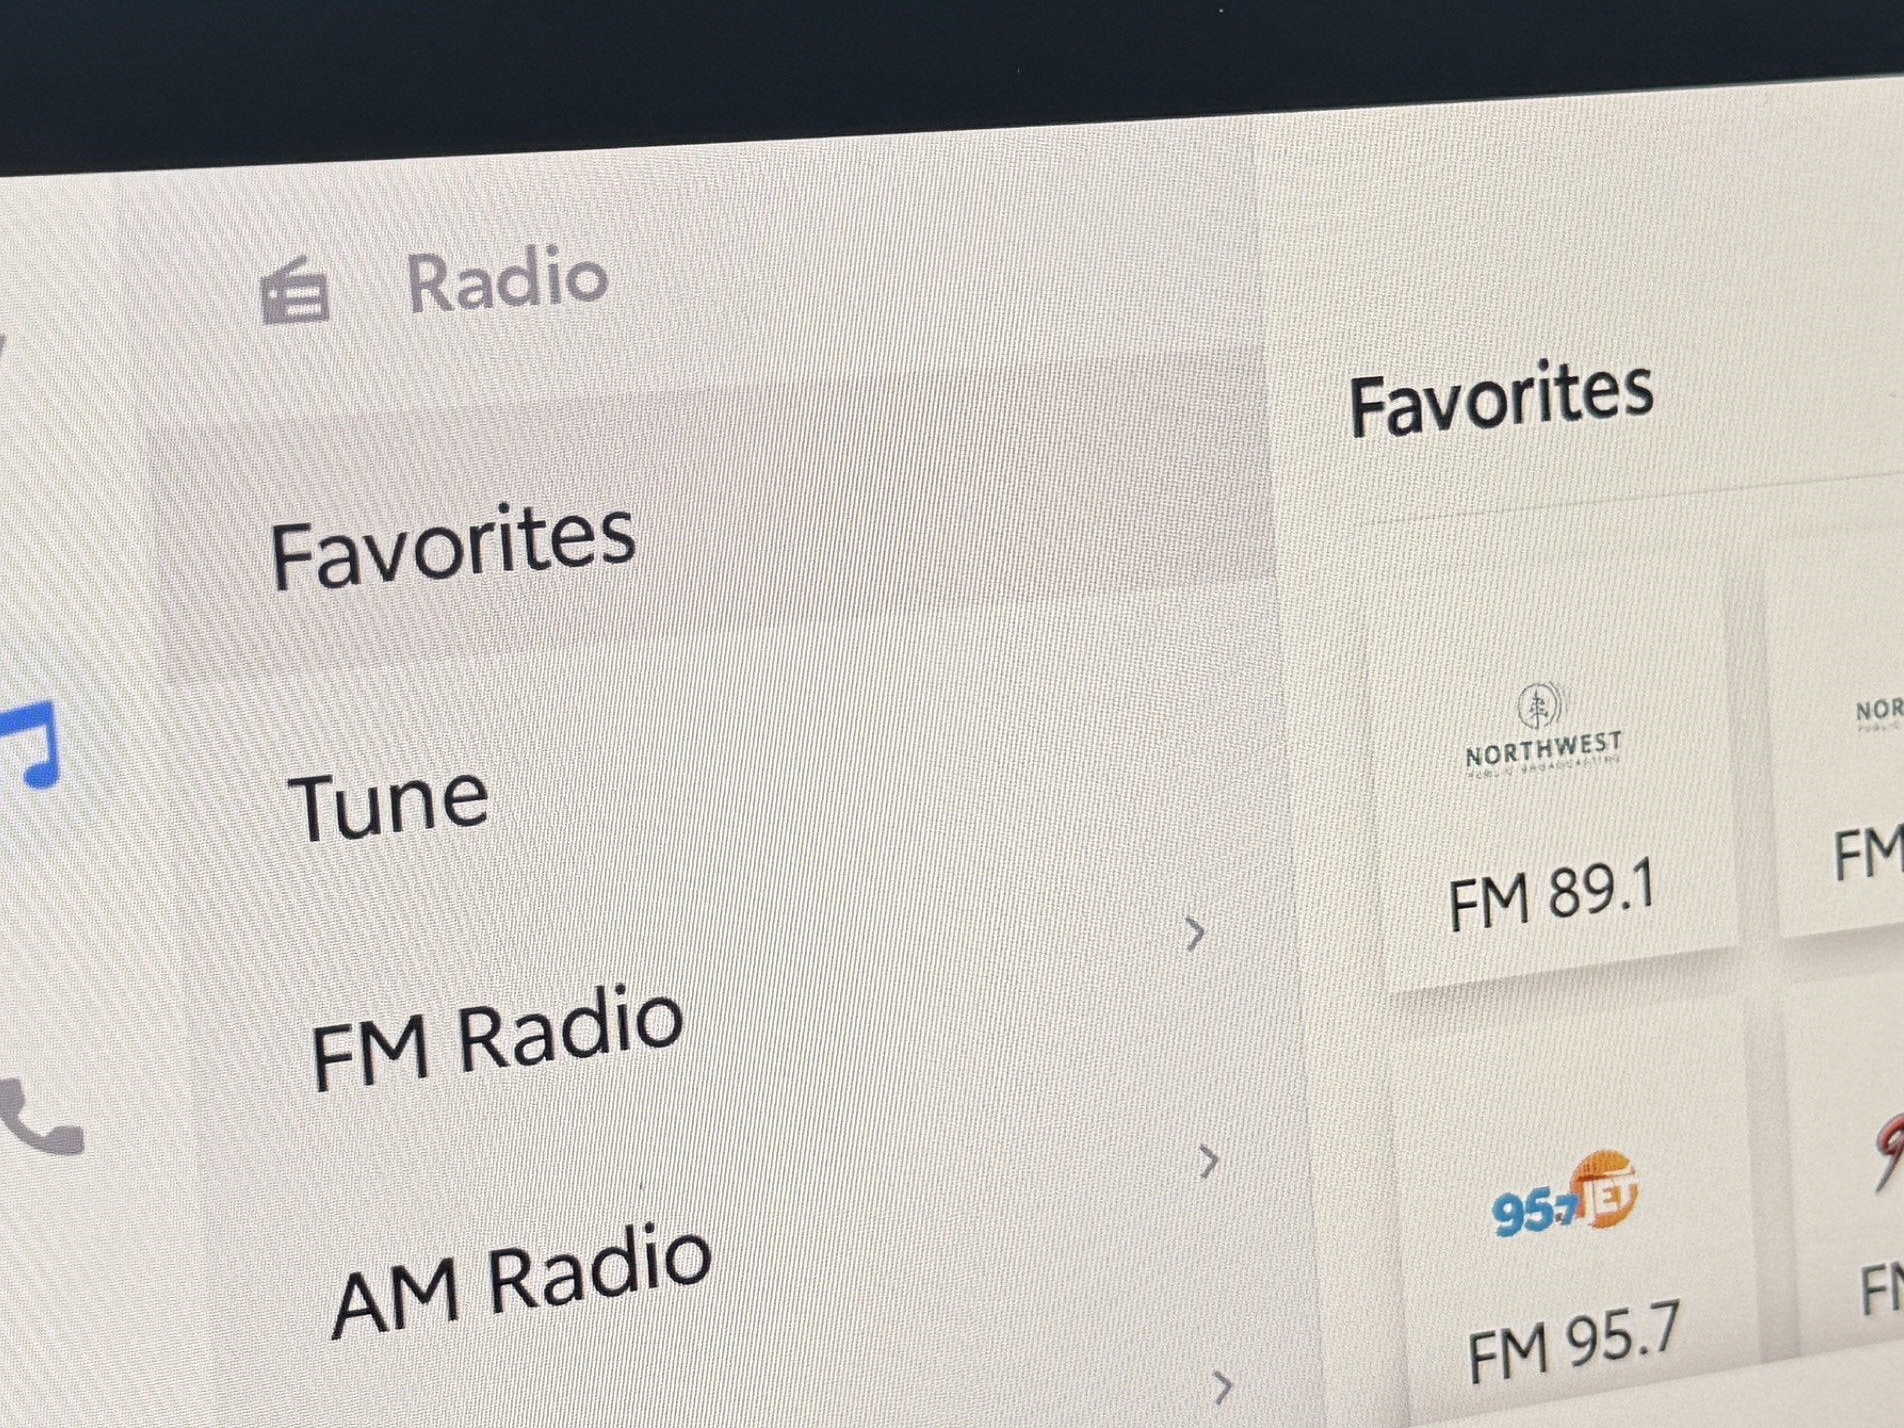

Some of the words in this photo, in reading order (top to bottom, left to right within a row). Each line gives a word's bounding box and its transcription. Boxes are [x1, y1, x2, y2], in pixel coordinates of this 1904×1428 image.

[407, 243, 610, 314] Radio
[1350, 357, 1655, 439] Favorites
[271, 501, 636, 592] Favorites
[1466, 730, 1622, 768] NORTHWEST
[286, 774, 489, 843] Tune
[1450, 871, 1529, 933] FM
[1549, 856, 1653, 920] 89.1
[313, 1013, 429, 1093] FM
[458, 983, 684, 1073] Radio
[1491, 1185, 1580, 1238] 95.7
[331, 1257, 459, 1341] AM
[488, 1221, 713, 1315] Radio
[1469, 1322, 1549, 1385] FM
[1566, 1298, 1682, 1369] 95.7
